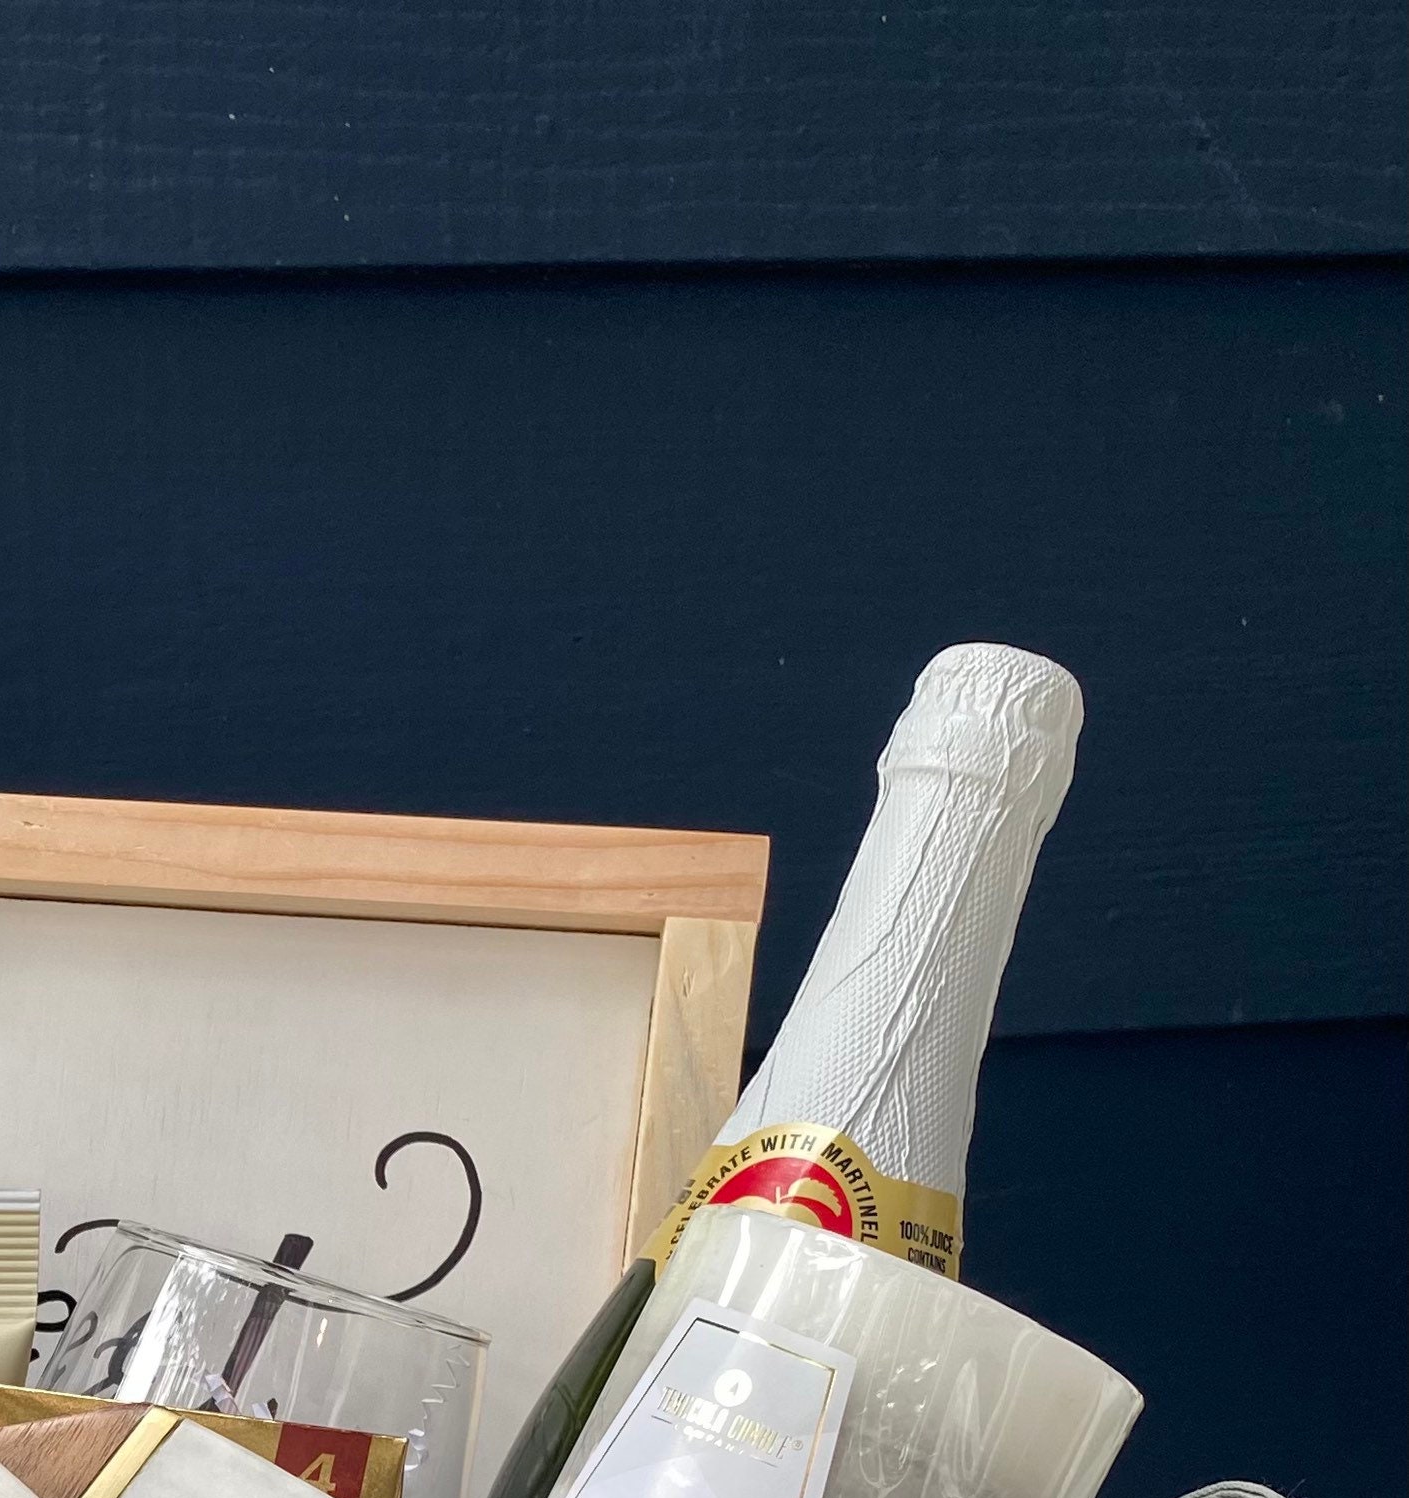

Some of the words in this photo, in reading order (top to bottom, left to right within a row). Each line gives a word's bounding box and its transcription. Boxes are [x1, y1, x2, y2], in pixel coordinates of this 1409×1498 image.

[760, 1133, 818, 1154] WITH
[899, 1220, 929, 1246] 100%
[929, 1229, 954, 1255] JUICE
[299, 1452, 337, 1493] 4
